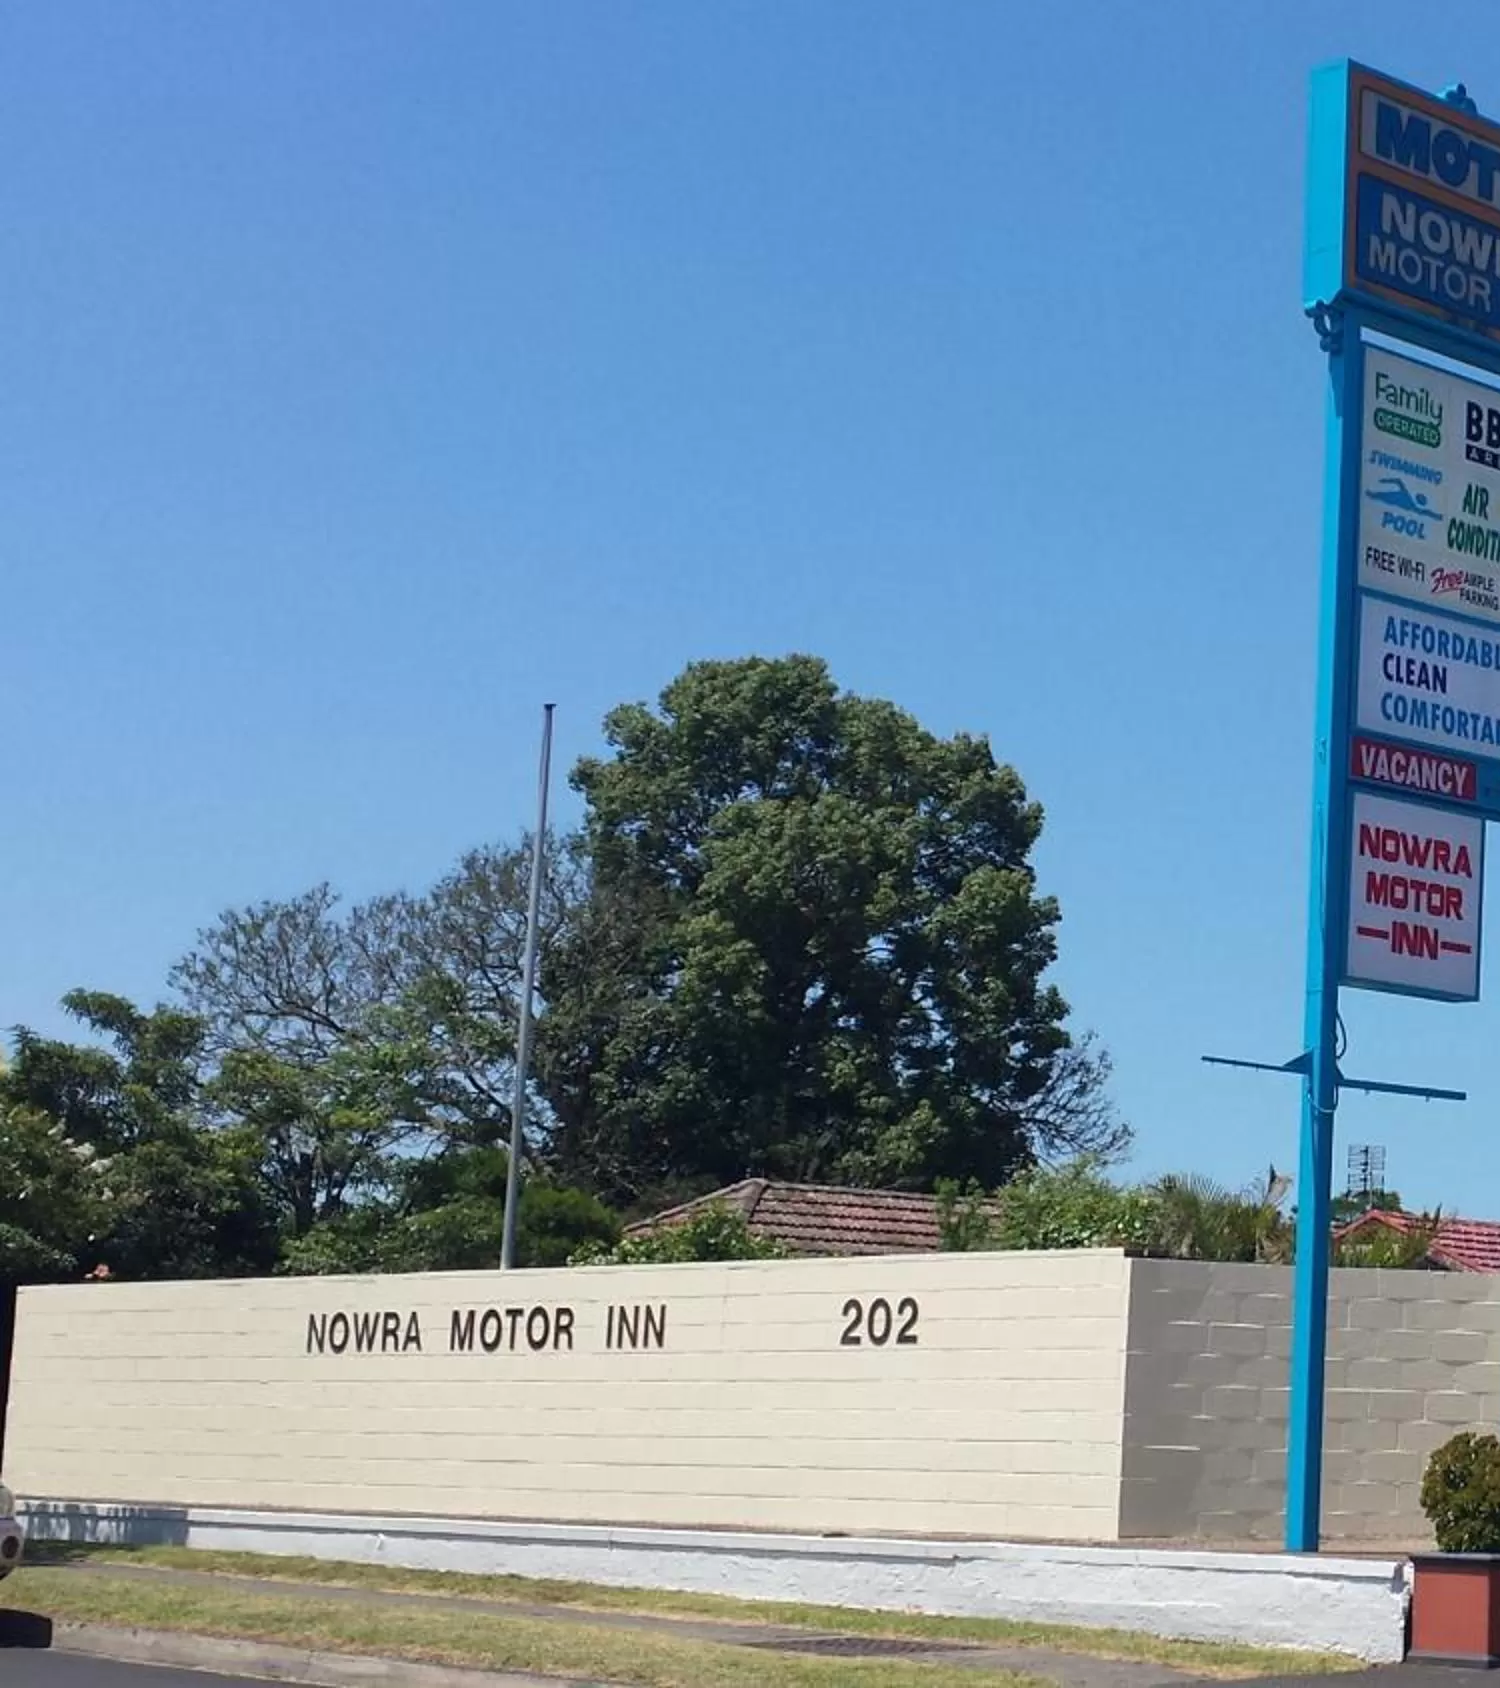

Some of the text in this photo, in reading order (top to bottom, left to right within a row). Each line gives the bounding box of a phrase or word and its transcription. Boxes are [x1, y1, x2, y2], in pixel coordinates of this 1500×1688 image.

[1369, 235, 1490, 312] MOTOR
[1375, 372, 1443, 425] Family
[1376, 411, 1439, 446] OPERATED
[1368, 450, 1443, 485] SWIMMING
[1463, 483, 1489, 521] AIR
[1382, 511, 1426, 540] POOL
[1366, 546, 1425, 582] FREE WI-FI
[1431, 567, 1464, 593] Free
[1463, 574, 1495, 593] AMPLE
[1460, 587, 1500, 612] PARKING
[1383, 653, 1447, 694] CLEAN
[1360, 744, 1469, 797] VACANCY
[1359, 823, 1472, 879] NOWRA
[1365, 871, 1463, 921] MOTOR
[306, 1304, 668, 1355] NOWRA MOTOR INN
[840, 1297, 919, 1346] 202
